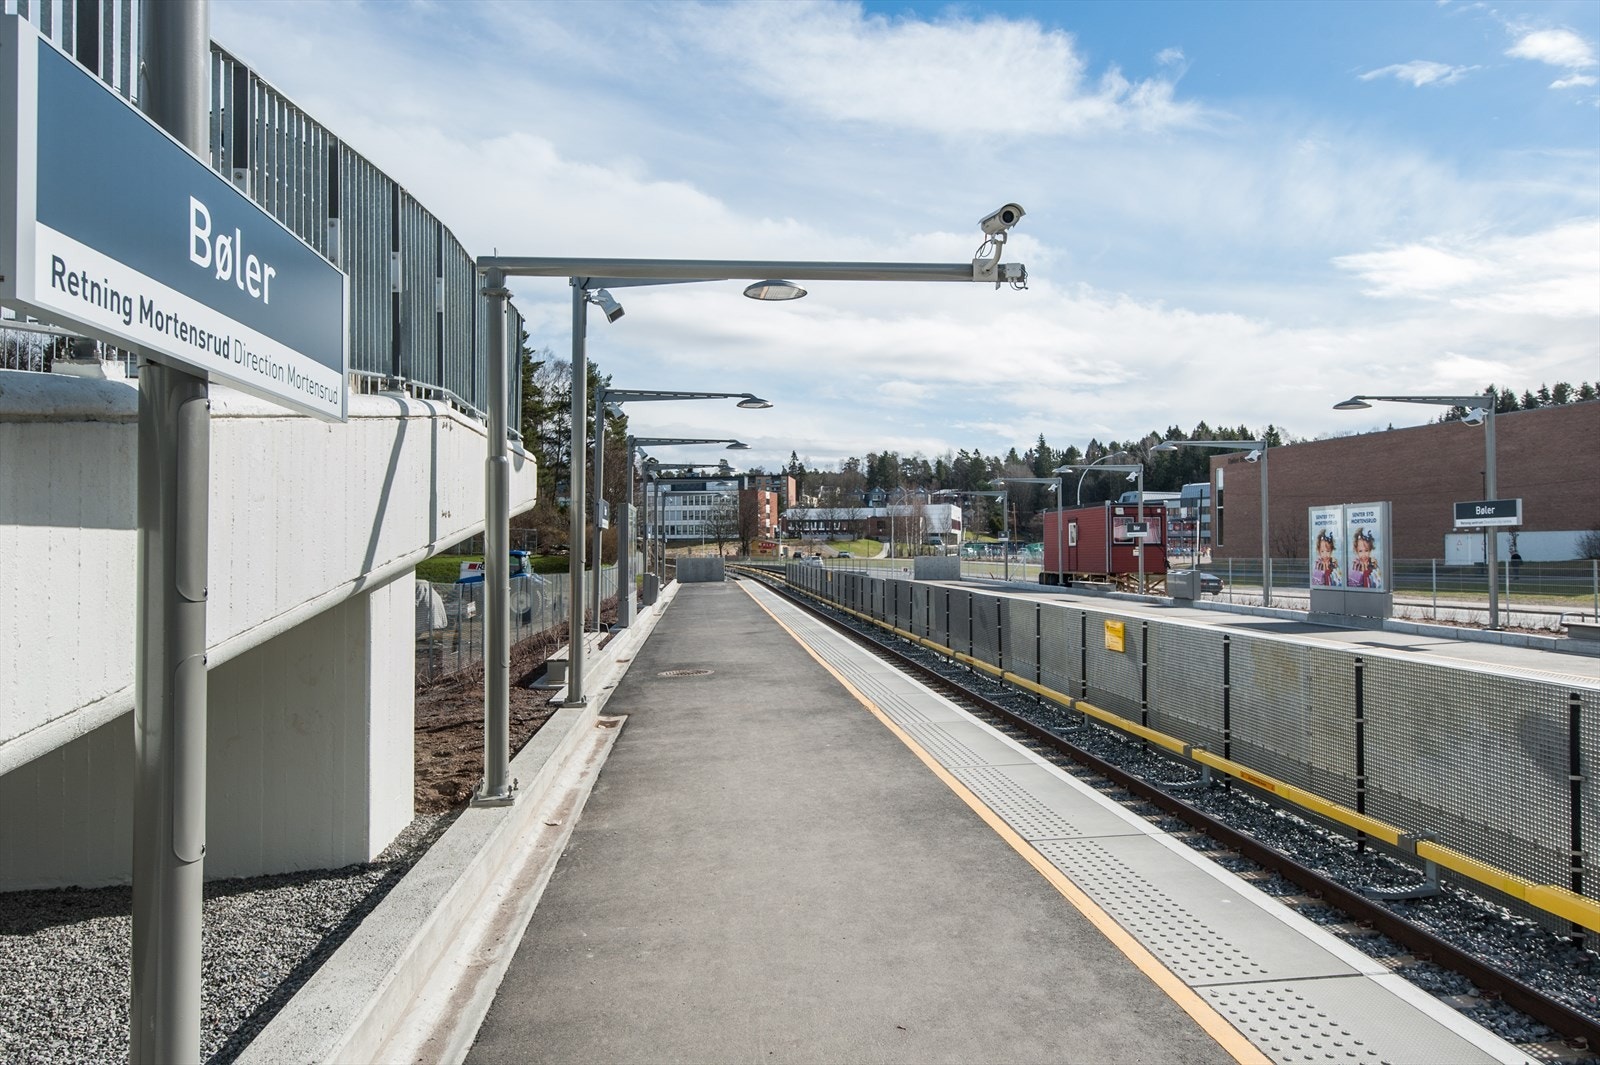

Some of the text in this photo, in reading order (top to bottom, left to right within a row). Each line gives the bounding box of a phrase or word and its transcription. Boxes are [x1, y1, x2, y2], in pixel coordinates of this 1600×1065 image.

[189, 194, 277, 306] Bøler
[51, 254, 339, 406] Retning Mortensrud Direction Mortensrud
[1475, 505, 1496, 515] Bøler
